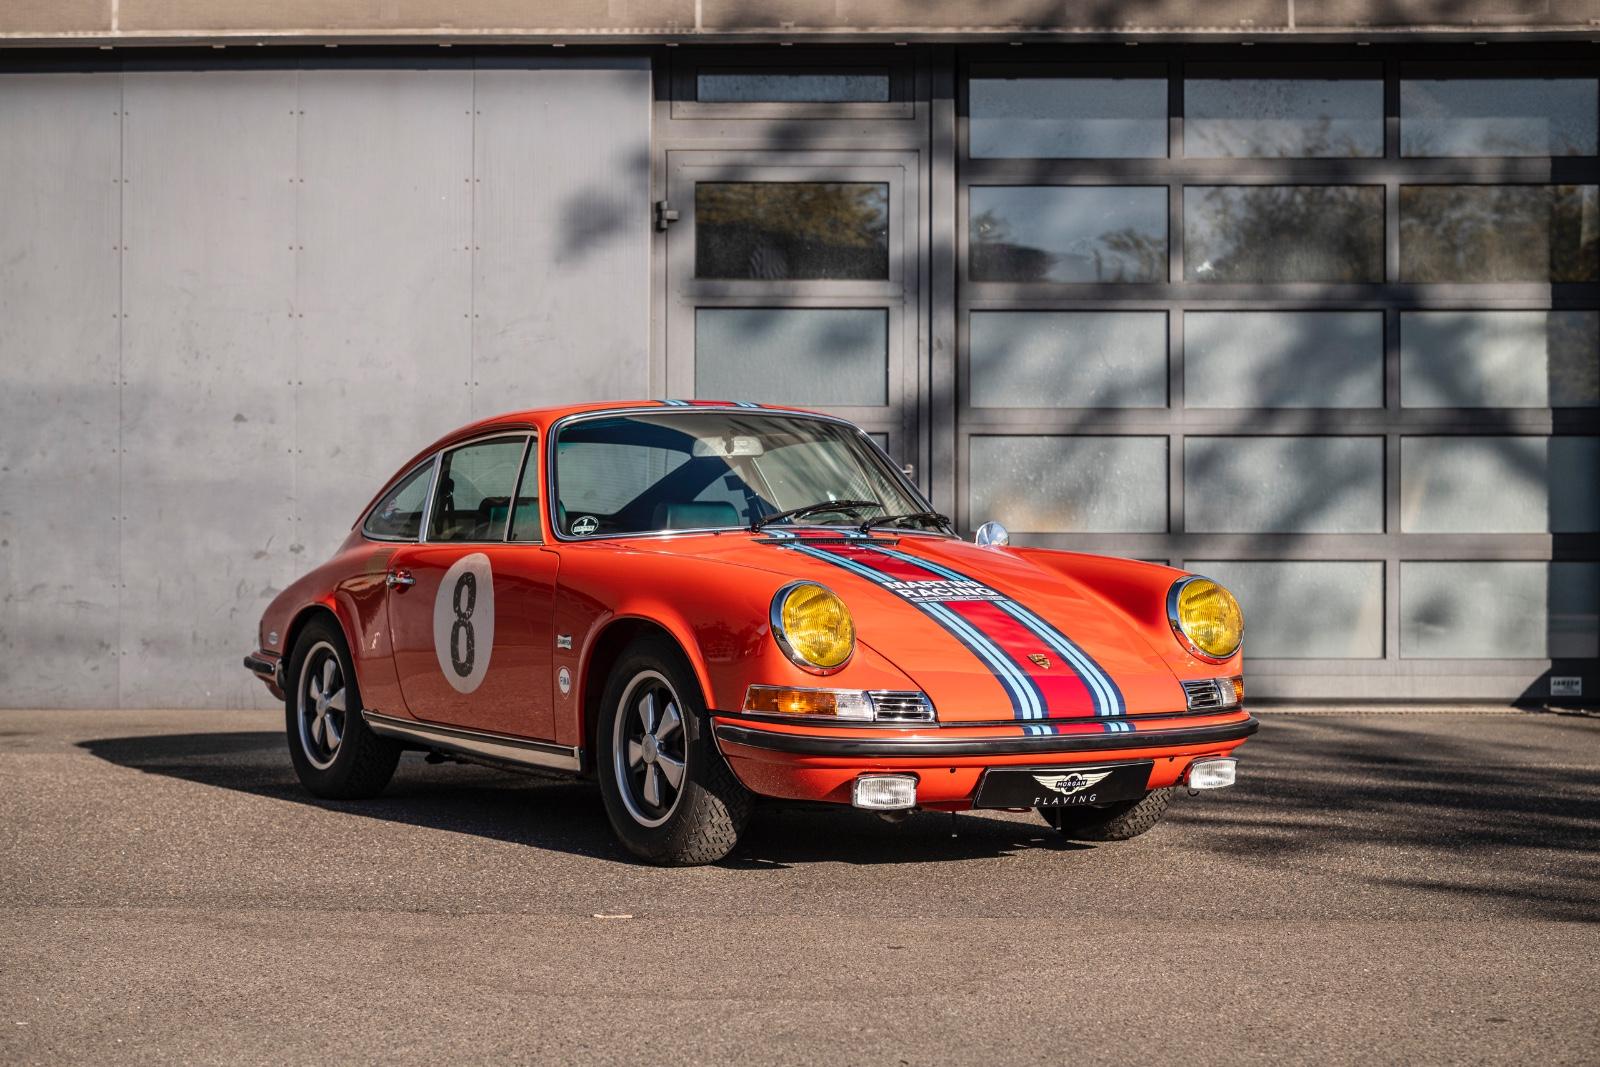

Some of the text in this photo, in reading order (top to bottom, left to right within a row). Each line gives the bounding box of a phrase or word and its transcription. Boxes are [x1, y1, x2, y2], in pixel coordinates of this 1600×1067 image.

[881, 580, 985, 589] MARTINI
[895, 588, 1000, 598] RACING
[450, 571, 477, 678] 8
[1033, 793, 1097, 805] FLAVING
